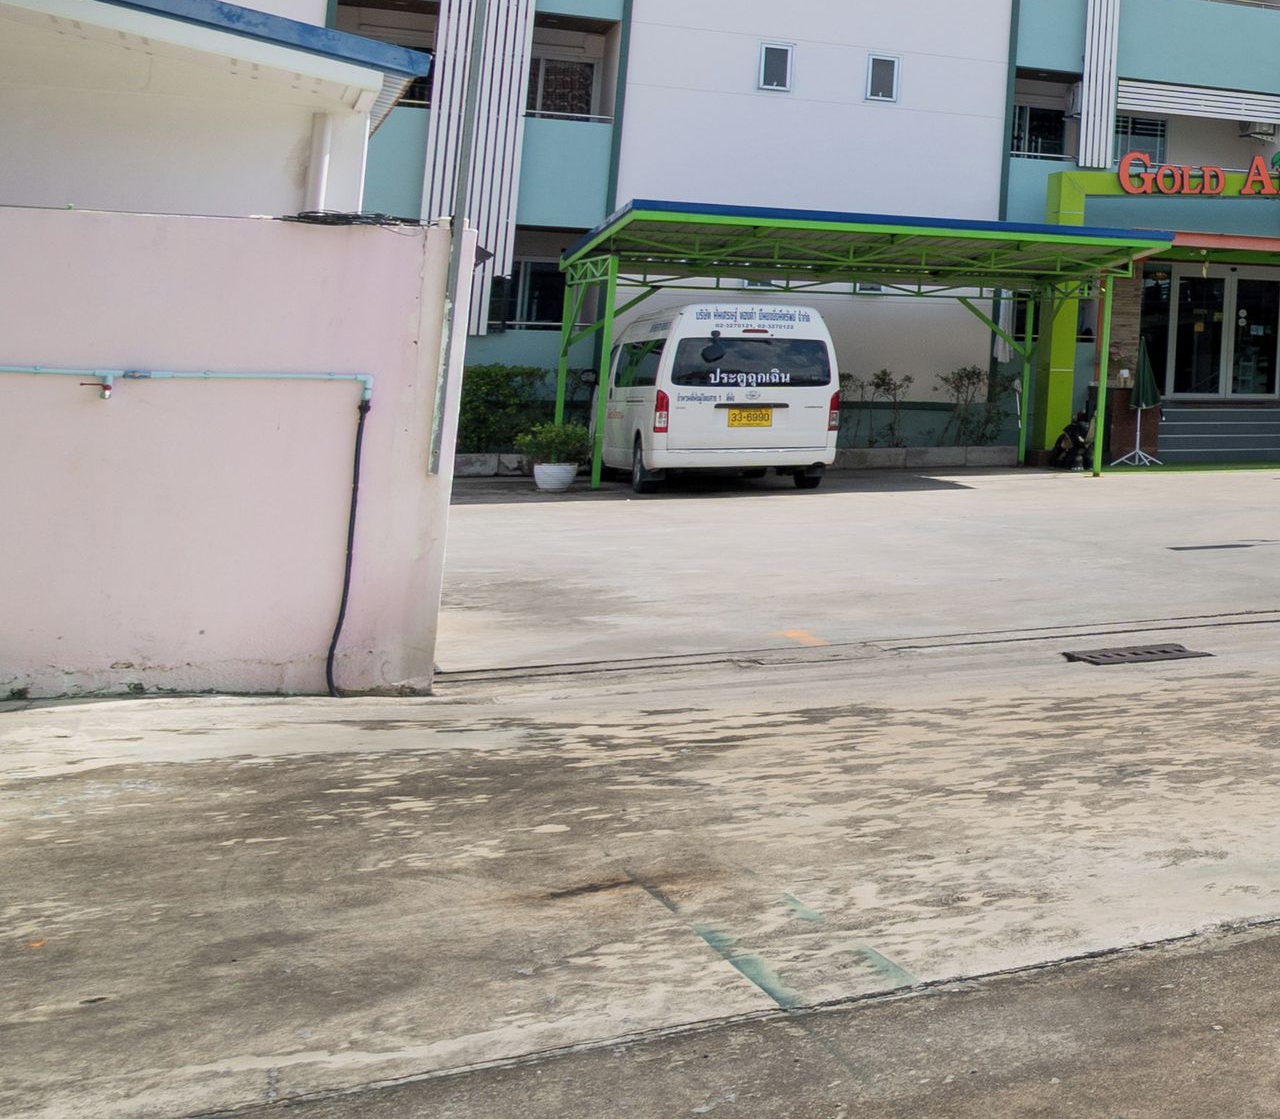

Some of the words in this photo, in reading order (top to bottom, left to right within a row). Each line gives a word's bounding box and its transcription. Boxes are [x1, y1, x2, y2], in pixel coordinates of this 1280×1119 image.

[1119, 151, 1226, 194] GOLD
[709, 368, 790, 387] ประตูฉุกเฉิน
